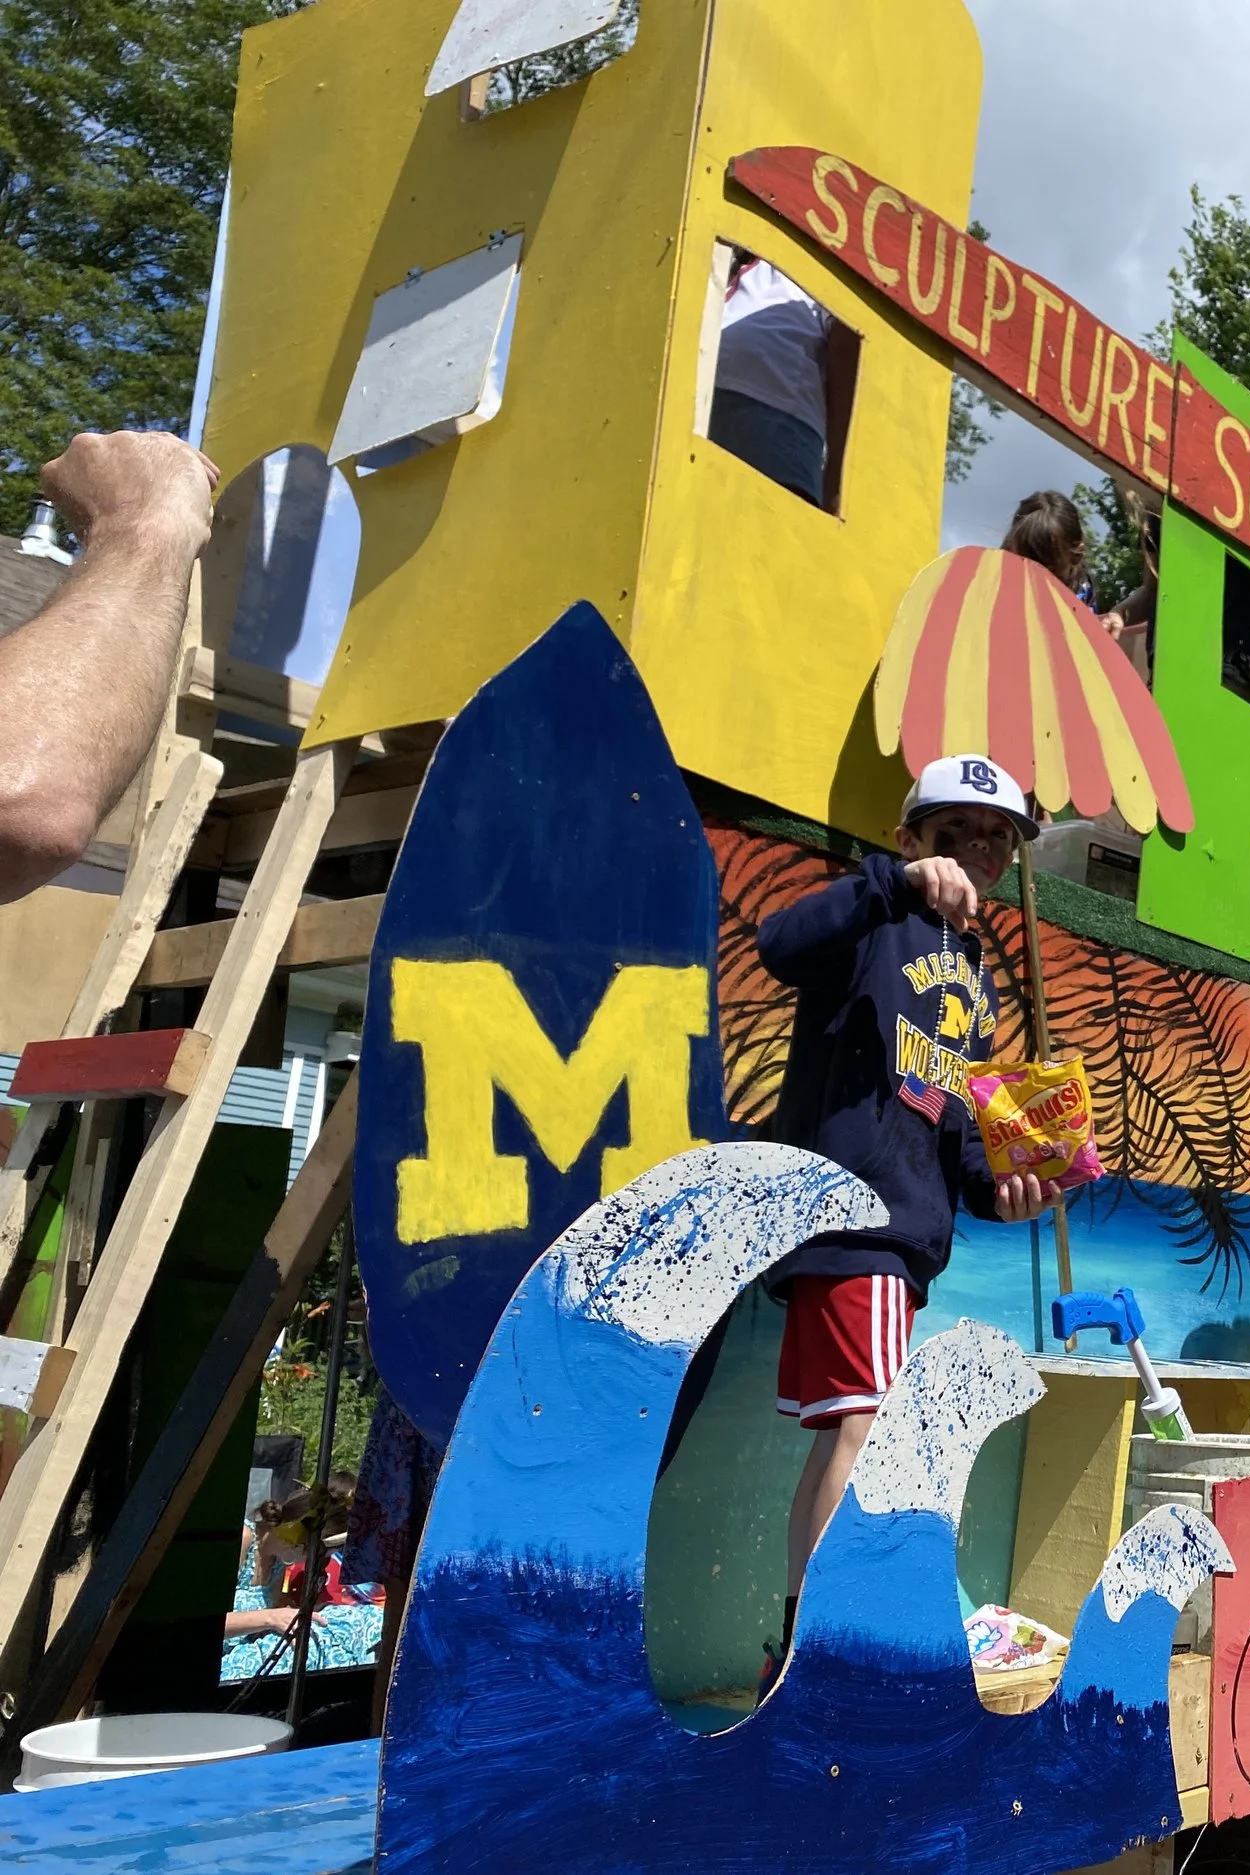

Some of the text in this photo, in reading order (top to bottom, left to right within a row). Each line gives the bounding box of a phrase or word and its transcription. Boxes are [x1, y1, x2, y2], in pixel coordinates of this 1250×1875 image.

[804, 154, 1194, 496] SCULPTURE
[391, 956, 711, 1246] M
[986, 1079, 1084, 1149] Starburst
